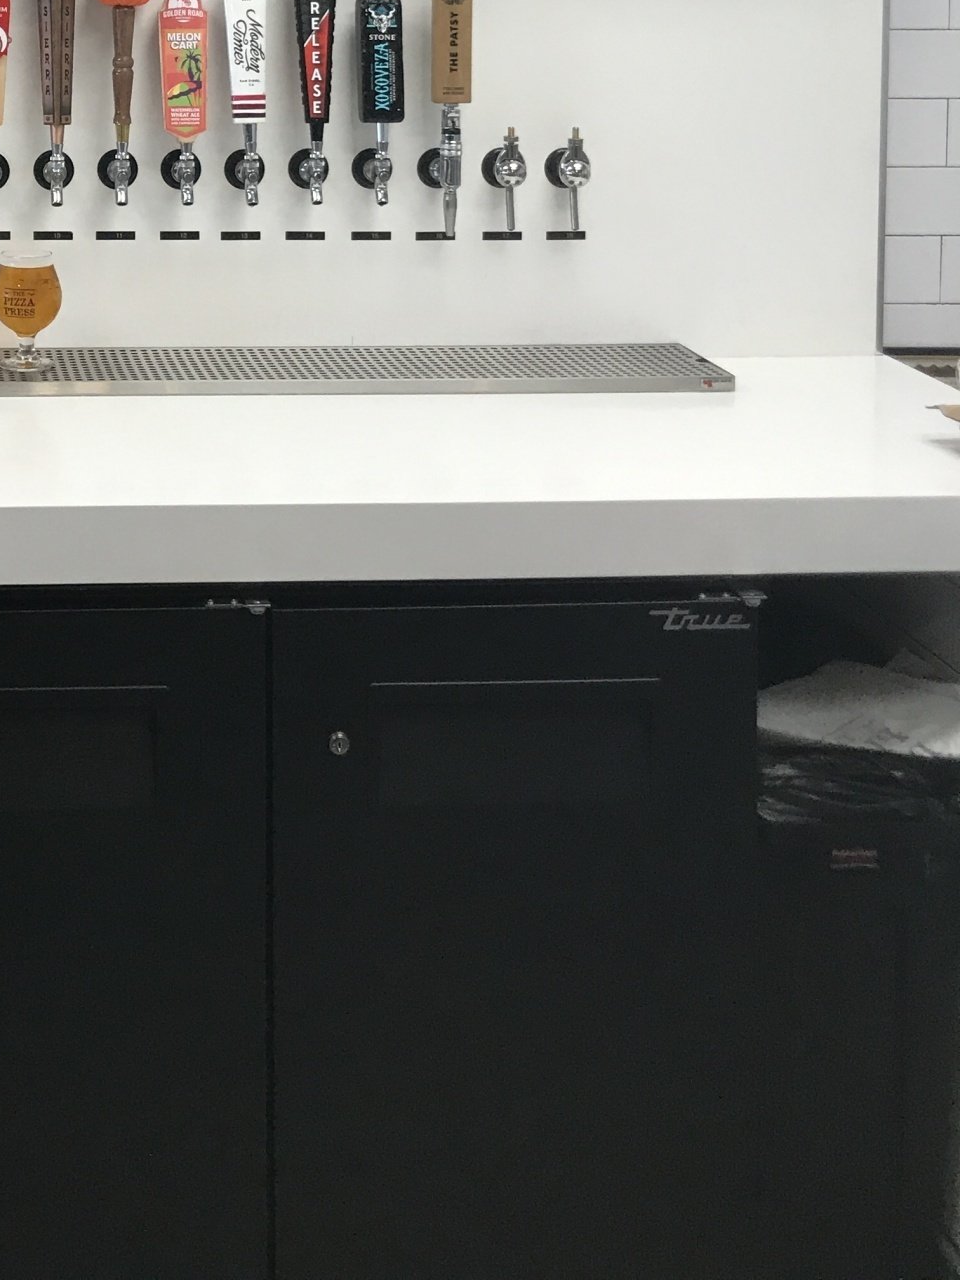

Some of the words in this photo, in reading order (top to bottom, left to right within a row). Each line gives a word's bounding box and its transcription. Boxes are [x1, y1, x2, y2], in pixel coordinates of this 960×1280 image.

[163, 9, 186, 18] GOLDEN
[188, 9, 204, 18] ROAD
[167, 32, 201, 41] MELON
[450, 11, 459, 47] PATSY
[171, 41, 198, 50] CART
[233, 19, 249, 65] Times
[246, 9, 266, 74] Modern
[309, 1, 322, 114] RELEASE
[450, 52, 458, 73] THE
[374, 42, 390, 111] XOCOVEZA
[3, 297, 36, 307] PIZZA
[3, 307, 36, 317] PRESS
